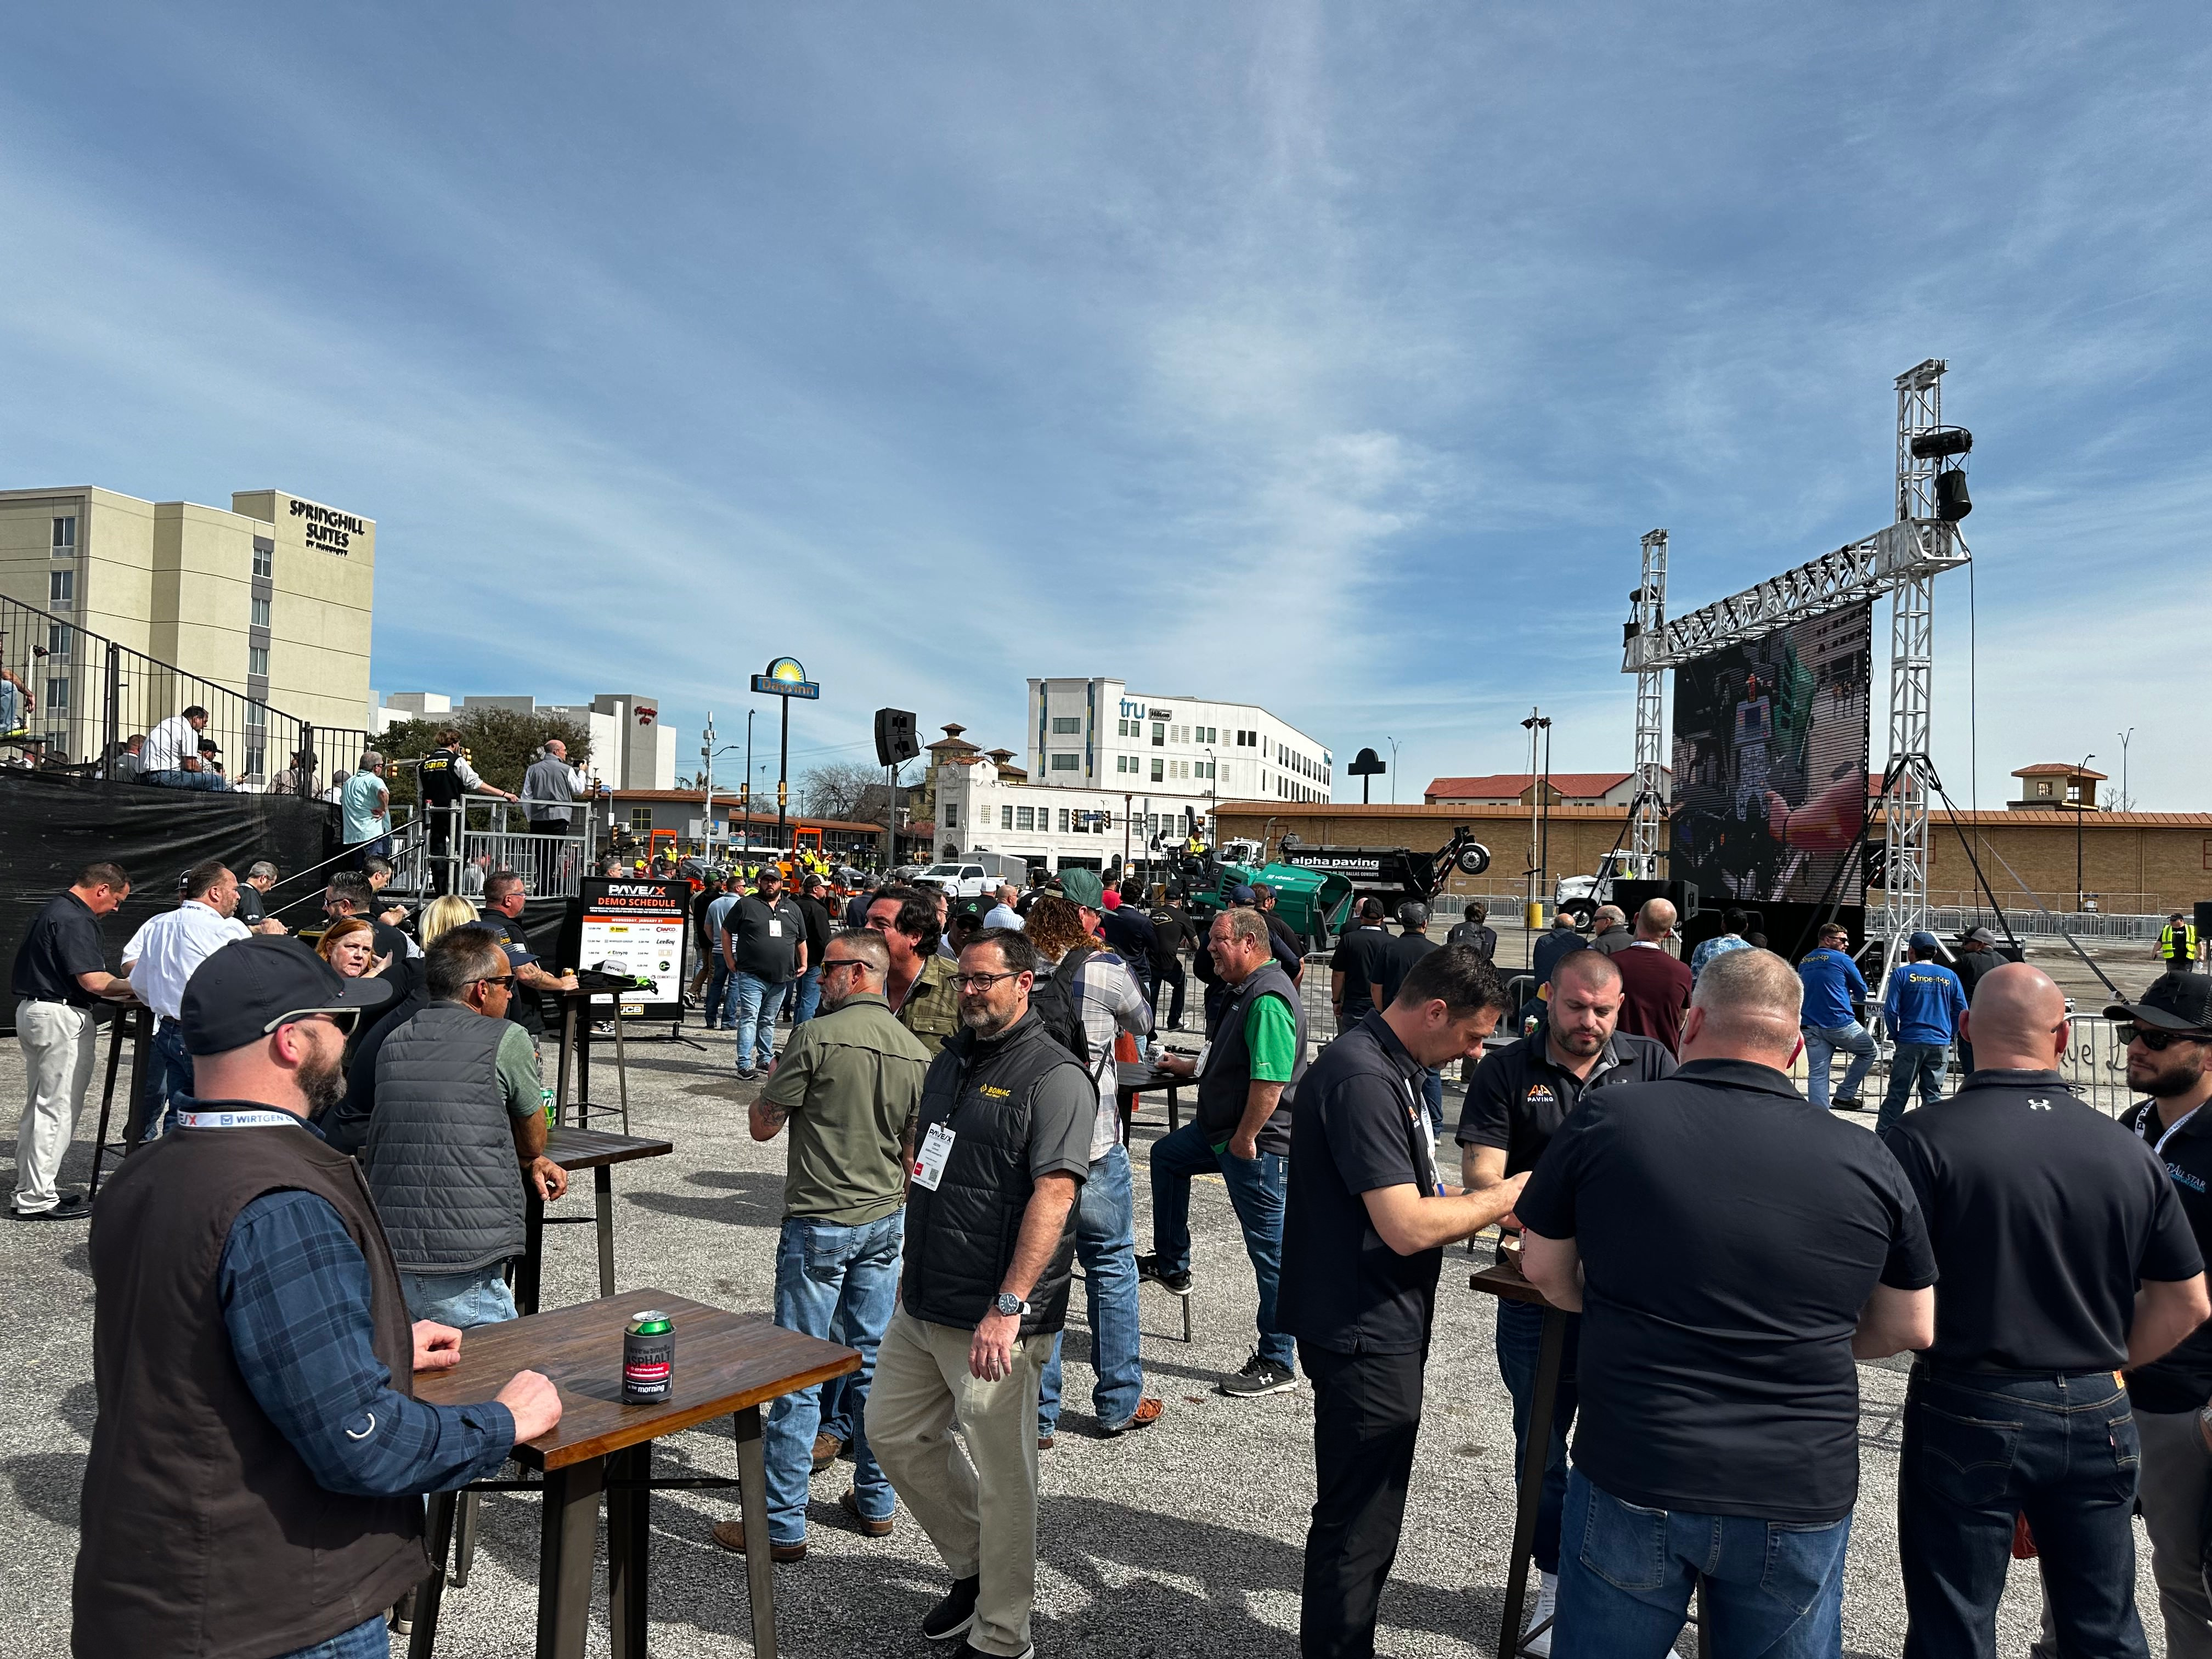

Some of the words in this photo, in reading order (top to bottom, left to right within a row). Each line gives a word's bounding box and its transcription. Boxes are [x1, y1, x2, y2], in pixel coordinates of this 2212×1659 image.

[290, 500, 365, 535] SPRINGHILL
[306, 523, 349, 548] SUITES
[306, 540, 315, 548] BY
[316, 542, 348, 557] MARRIOTT
[763, 679, 792, 693] Days
[794, 684, 814, 696] Inn
[1119, 697, 1145, 719] tru
[1291, 856, 1330, 866] alpha
[1332, 858, 1380, 868] paving
[608, 884, 667, 895] PAVE/X
[597, 897, 627, 906] DEMO
[629, 898, 676, 907] SCHEDULE
[988, 1086, 1011, 1097] BOMAG
[236, 1115, 283, 1123] WIRTGEN
[929, 1128, 952, 1143] PAVE/X
[2186, 1173, 2207, 1188] STAR
[630, 1346, 642, 1355] love
[650, 1344, 667, 1354] smell
[627, 1350, 671, 1368] ASPHALT
[637, 1384, 665, 1393] morning
